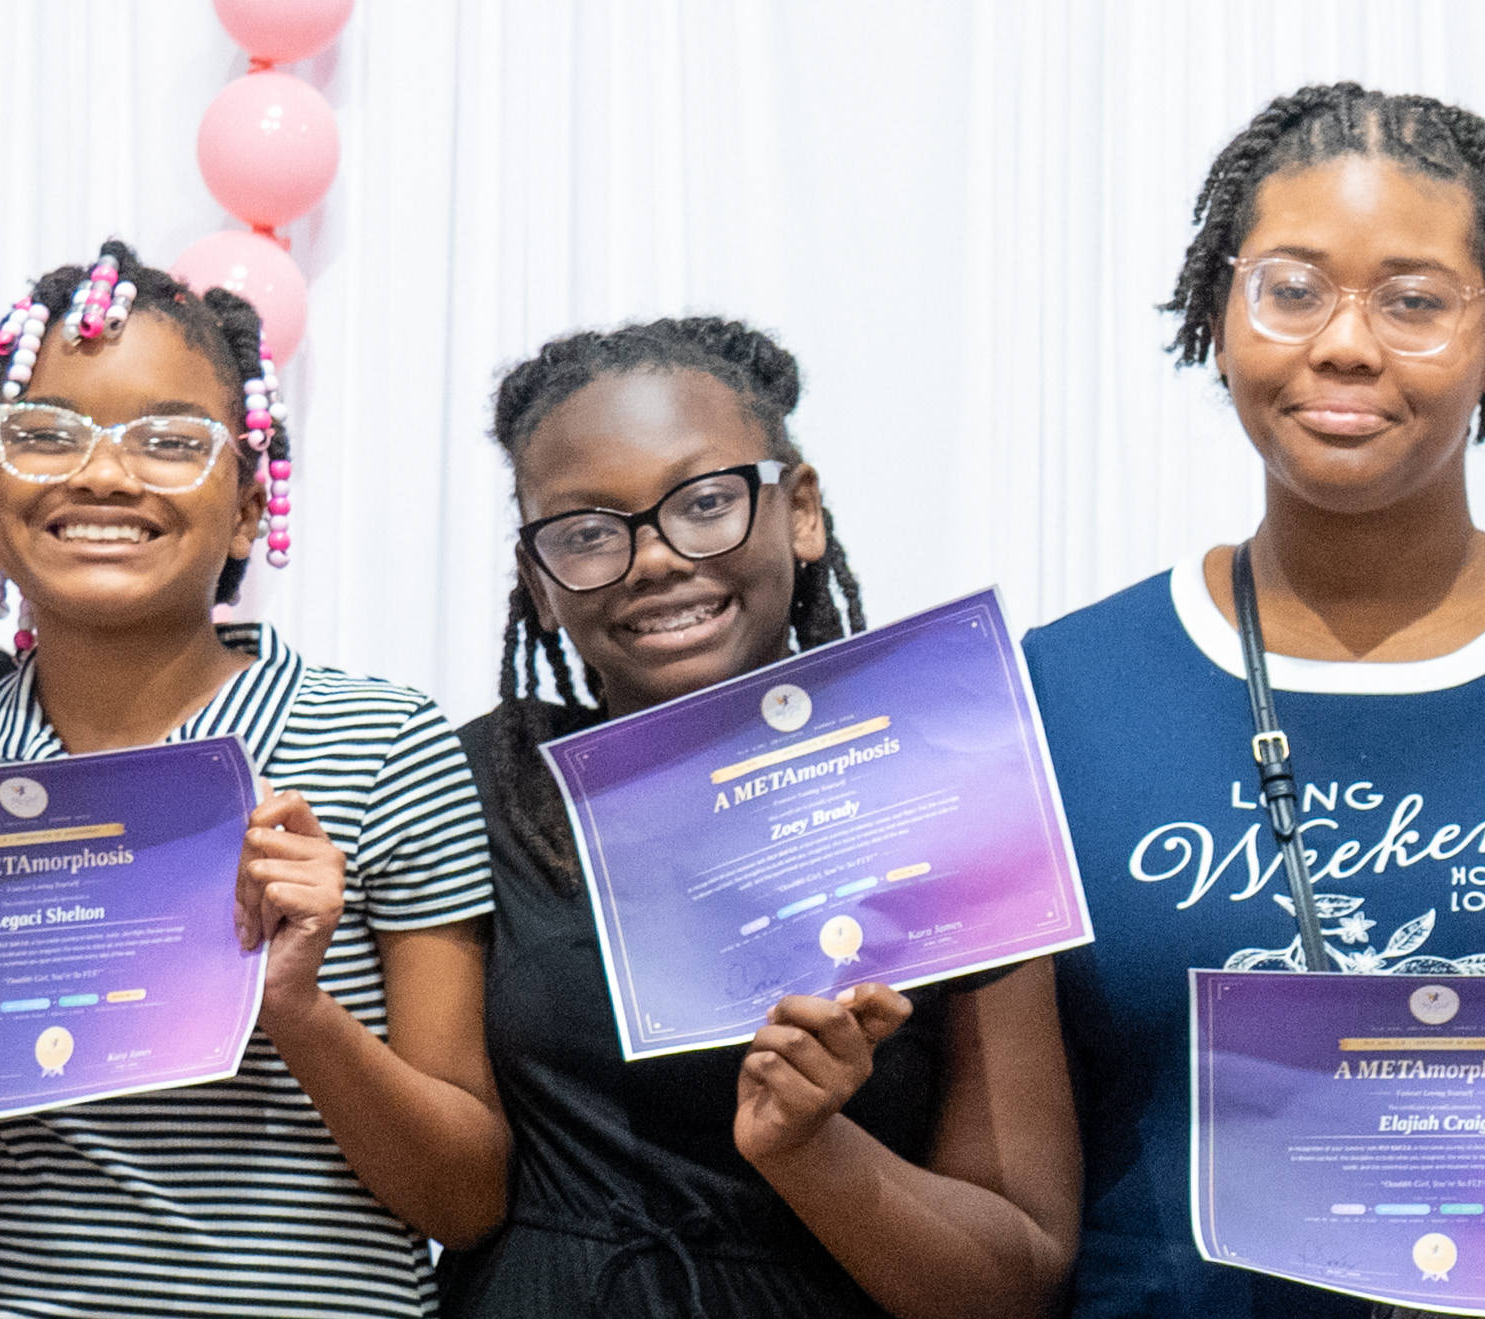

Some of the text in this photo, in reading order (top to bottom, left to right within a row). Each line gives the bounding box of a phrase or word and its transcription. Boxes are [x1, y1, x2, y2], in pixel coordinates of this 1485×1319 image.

[714, 737, 900, 813] A METAmorphosis
[1232, 781, 1384, 811] LNG
[771, 818, 808, 841] Zoey
[812, 800, 861, 828] Brady
[47, 904, 104, 924] Shelton
[1334, 1062, 1352, 1079] A
[1379, 1115, 1440, 1134] Elajiah
